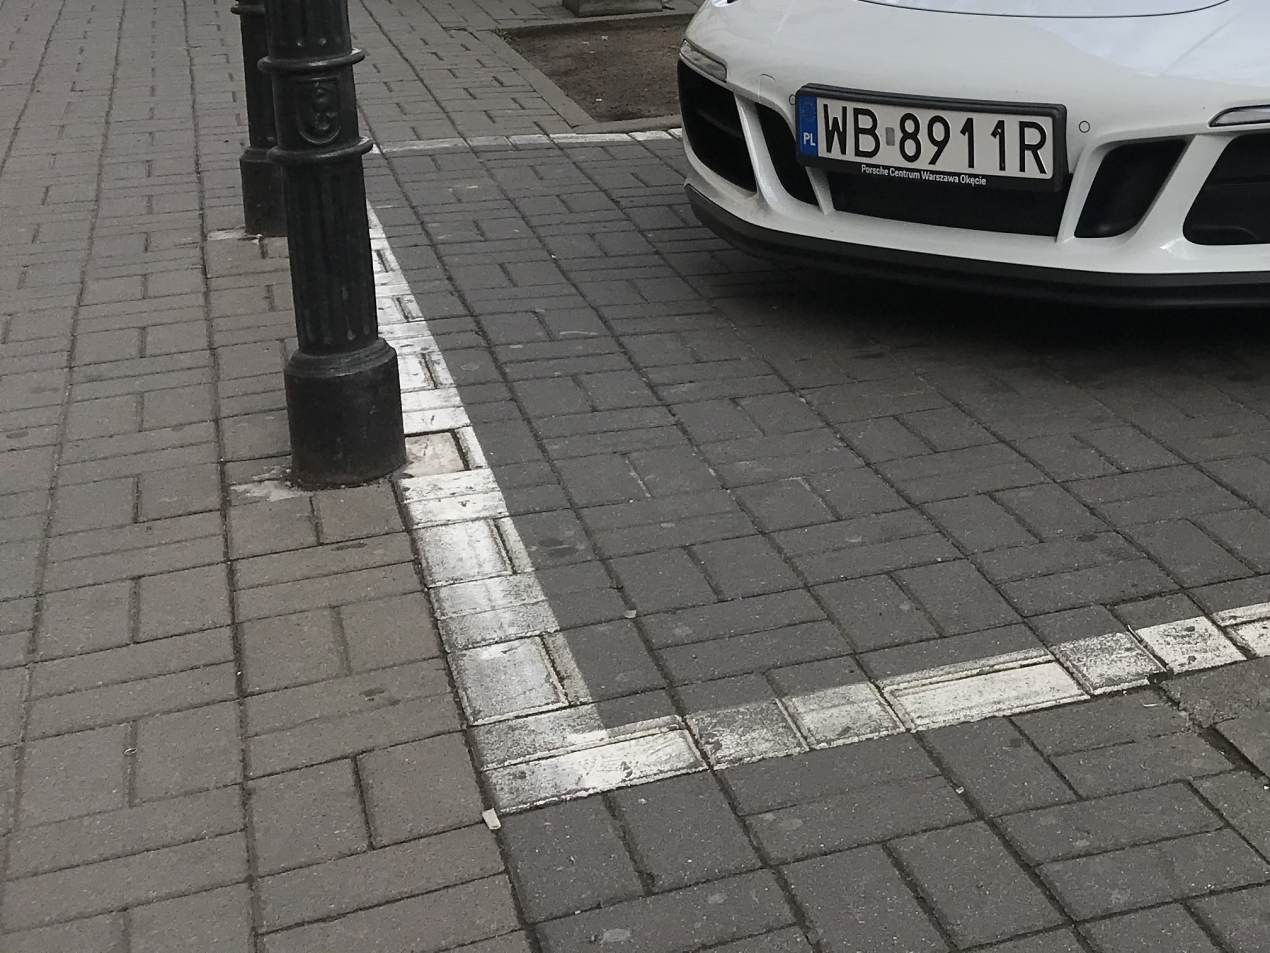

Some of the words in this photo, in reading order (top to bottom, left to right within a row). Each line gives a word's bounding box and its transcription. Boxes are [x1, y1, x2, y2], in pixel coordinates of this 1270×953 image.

[803, 132, 816, 146] PL
[823, 103, 881, 159] WB
[899, 112, 1048, 174] 8911R
[861, 164, 889, 176] Porsche
[889, 167, 920, 180] Centrum
[921, 171, 959, 183] Warszawa
[960, 174, 987, 187] Okęcie
